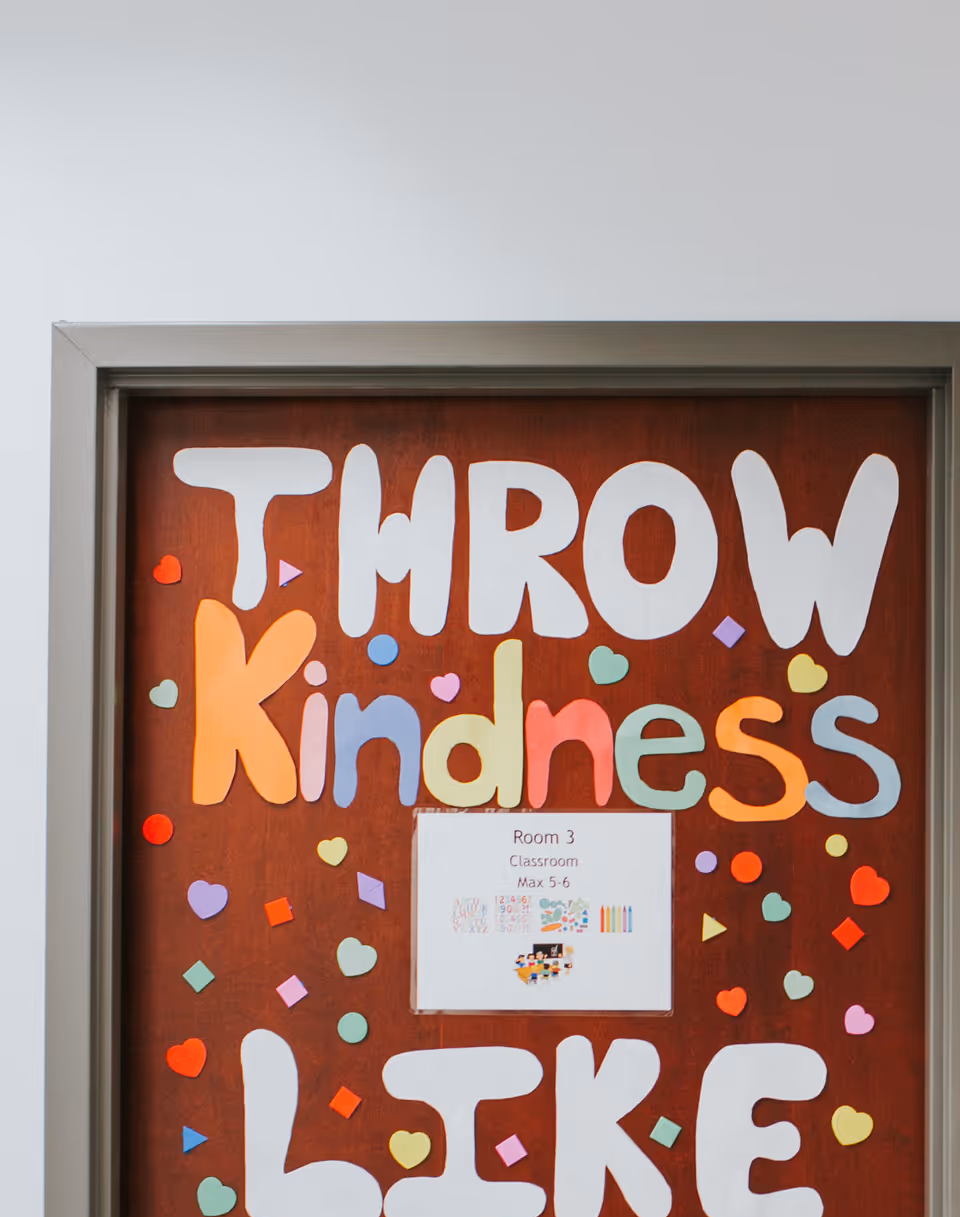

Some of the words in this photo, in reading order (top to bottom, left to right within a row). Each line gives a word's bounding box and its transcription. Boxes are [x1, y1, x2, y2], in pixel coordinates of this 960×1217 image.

[172, 443, 900, 657] THROW
[192, 598, 902, 823] Kindness
[513, 829, 559, 845] Room
[566, 829, 575, 845] 3
[509, 854, 579, 867] Classroom
[517, 876, 544, 889] Max
[548, 875, 571, 889] 5-6
